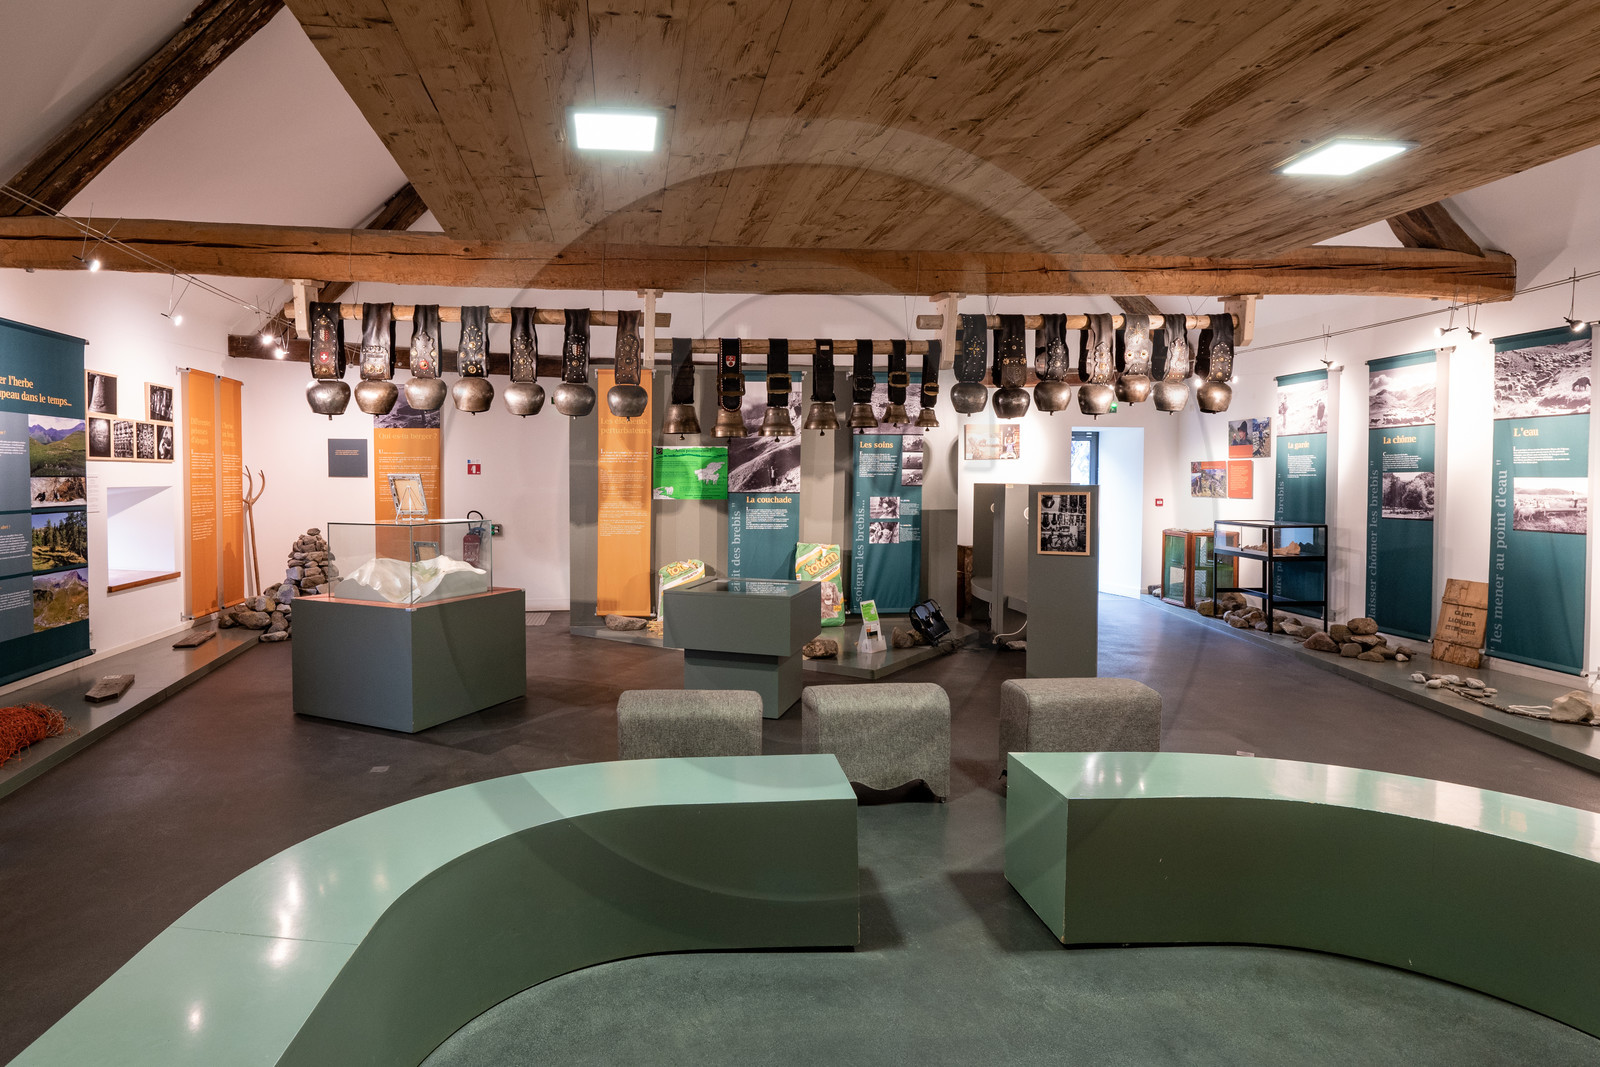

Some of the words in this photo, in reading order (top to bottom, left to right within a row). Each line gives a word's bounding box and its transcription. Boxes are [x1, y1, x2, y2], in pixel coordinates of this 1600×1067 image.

[8, 375, 34, 389] l'herbe
[21, 391, 38, 402] dans
[39, 393, 46, 403] le
[47, 396, 72, 407] temps...
[1513, 427, 1539, 437] L'eau
[1369, 470, 1378, 507] brebis
[1495, 470, 1507, 508] d'eau
[732, 511, 740, 544] brebis
[1370, 510, 1378, 527] les
[1495, 512, 1507, 549] point
[732, 547, 740, 566] des
[804, 552, 839, 575] totem
[855, 545, 864, 559] les
[1369, 531, 1377, 576] chômer
[1496, 553, 1505, 570] au
[854, 562, 865, 602] soigner
[1368, 579, 1376, 618] laisser
[1495, 574, 1504, 619] mener
[1491, 623, 1502, 643] les
